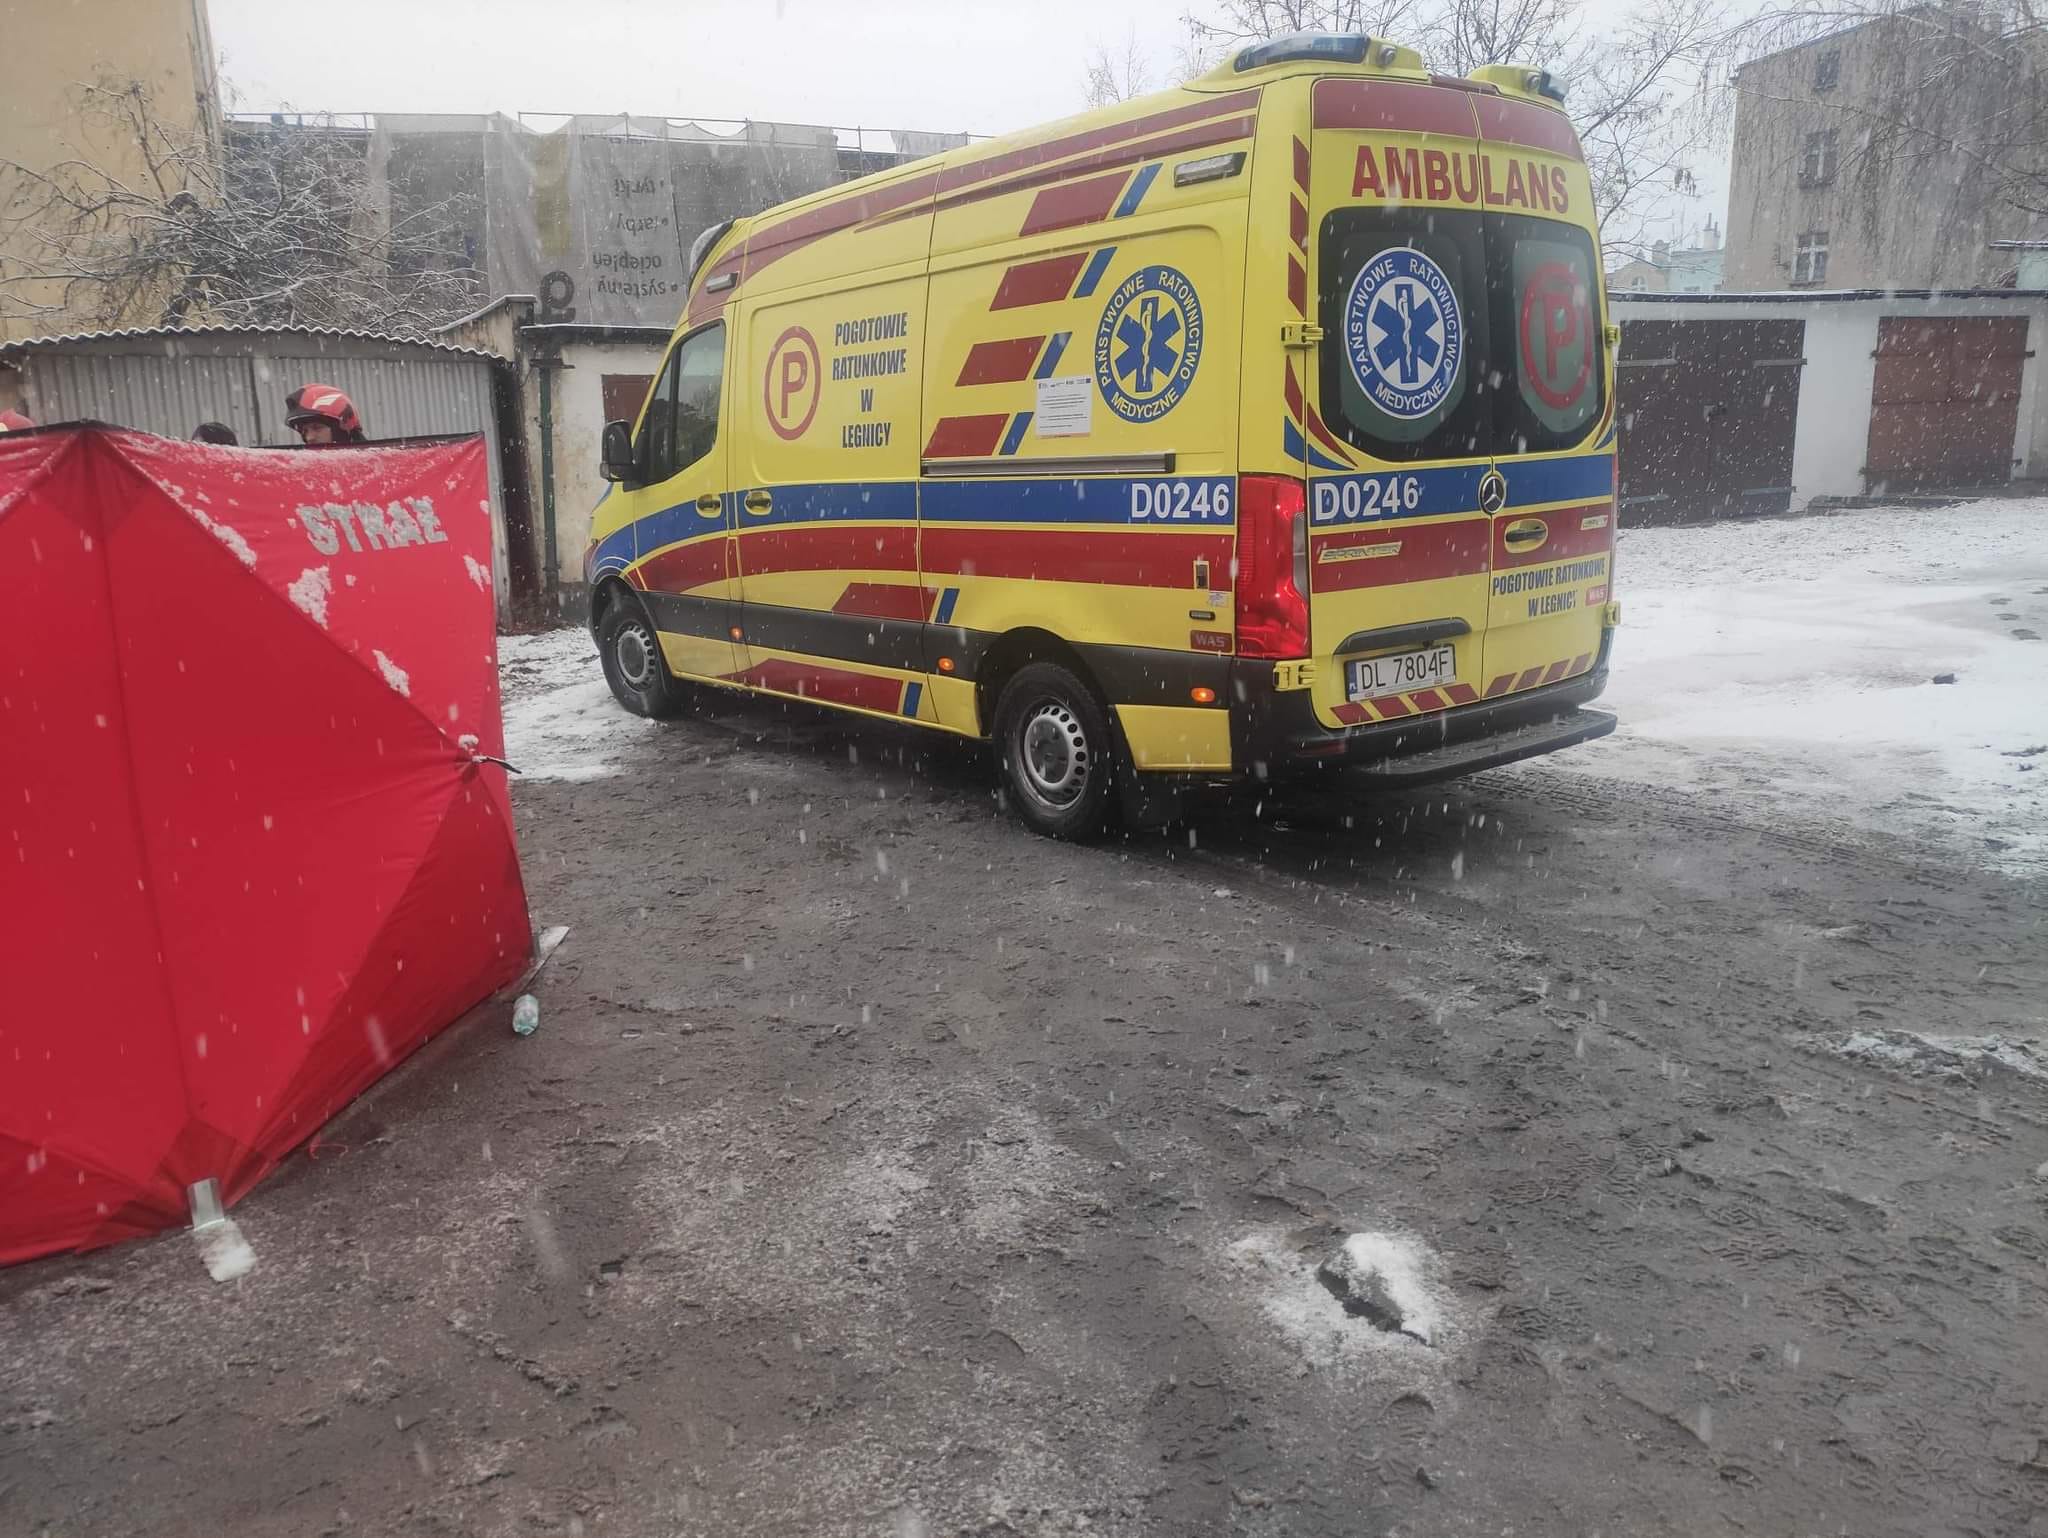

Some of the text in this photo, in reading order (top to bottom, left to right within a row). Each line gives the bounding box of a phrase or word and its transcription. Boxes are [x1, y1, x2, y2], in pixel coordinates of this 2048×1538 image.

[1351, 144, 1570, 214] AMBULANS
[597, 275, 666, 299] systemy
[835, 312, 908, 346] POGOTOWIE
[1096, 270, 1201, 418] PAŃSTWOWE RATOWNICTWO MEDYCZNE
[1350, 258, 1457, 411] PAŃSTWOWE RATOWNICTWO MEDYCZNE
[1541, 292, 1577, 380] P
[832, 349, 907, 381] RATUNKOWE
[781, 351, 808, 418] P
[860, 388, 873, 413] W
[842, 422, 892, 449] LEGNICY
[1131, 482, 1230, 519] D0246
[1314, 476, 1419, 521] D0246
[1492, 557, 1606, 596] POGOTOWIE RATUNKOWE
[1528, 597, 1538, 617] W
[1195, 634, 1225, 648] WAS
[1361, 662, 1386, 690] DL
[1393, 650, 1449, 684] 7804F
